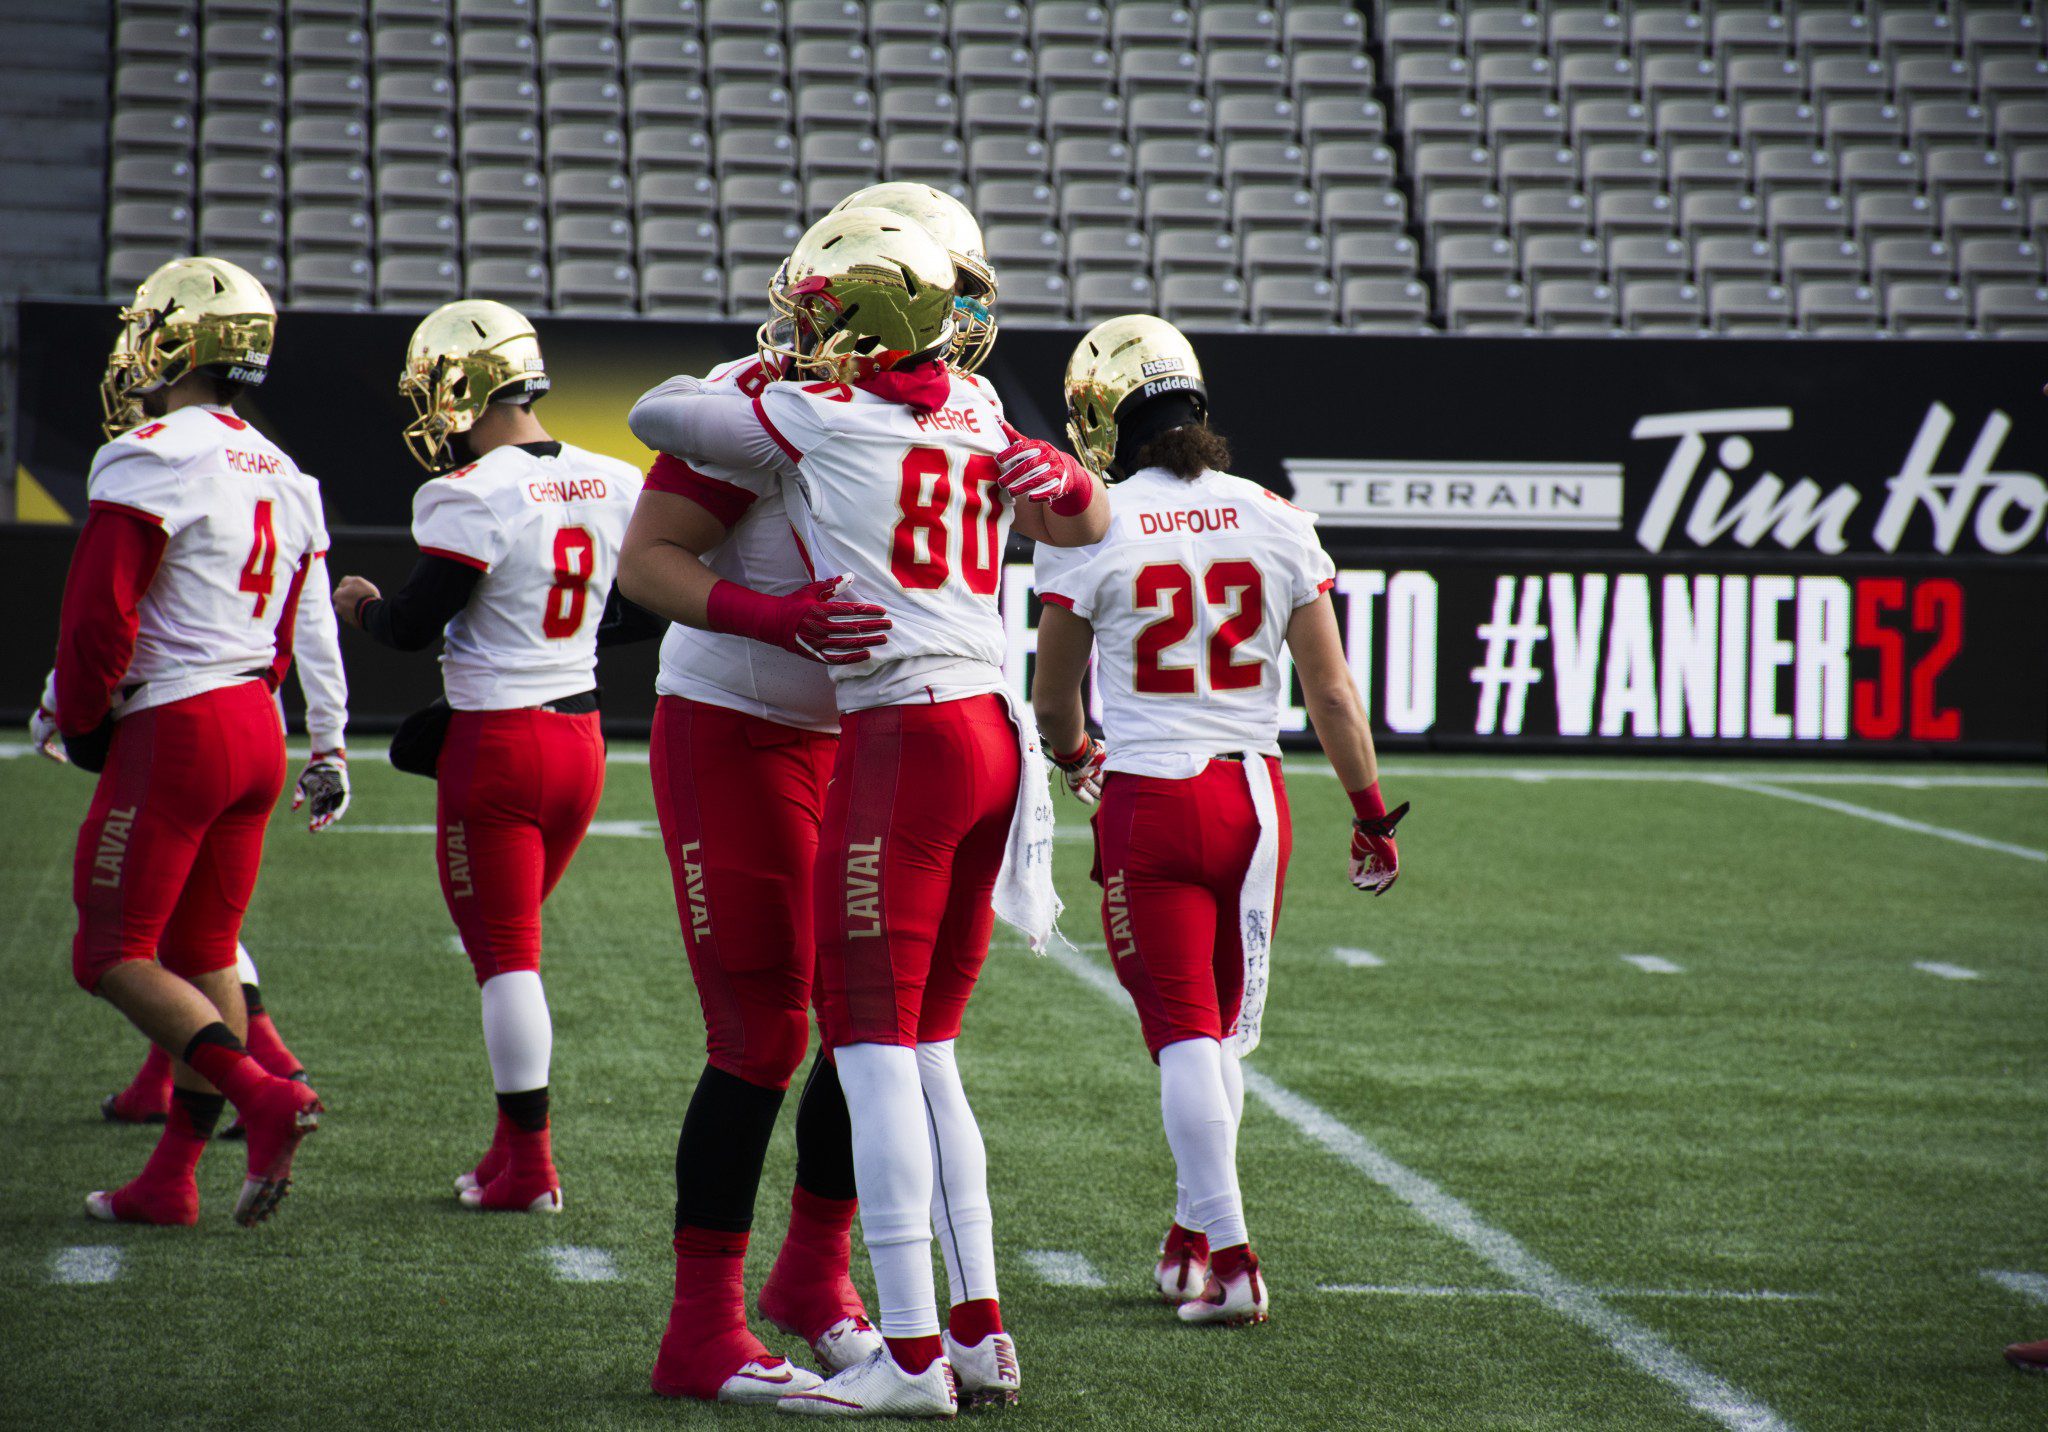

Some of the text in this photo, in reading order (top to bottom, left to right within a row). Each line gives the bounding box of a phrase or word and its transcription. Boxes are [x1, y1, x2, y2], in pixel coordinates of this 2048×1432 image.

[1144, 376, 1198, 398] Riddell
[888, 444, 1004, 595] 80
[1139, 507, 1240, 535] DUFOUR
[1326, 479, 1585, 508] TERRAIN
[1631, 400, 2048, 556] Tim Ho
[238, 498, 278, 620] 4
[541, 525, 595, 641] 8
[1132, 557, 1265, 697] 22
[1470, 572, 1964, 741] #VANIER52
[92, 806, 137, 888] LAVAL
[446, 821, 474, 900] LAVAL
[682, 839, 711, 944] LAVAL
[847, 836, 882, 940] LAVAL
[1107, 868, 1136, 960] LAVAL
